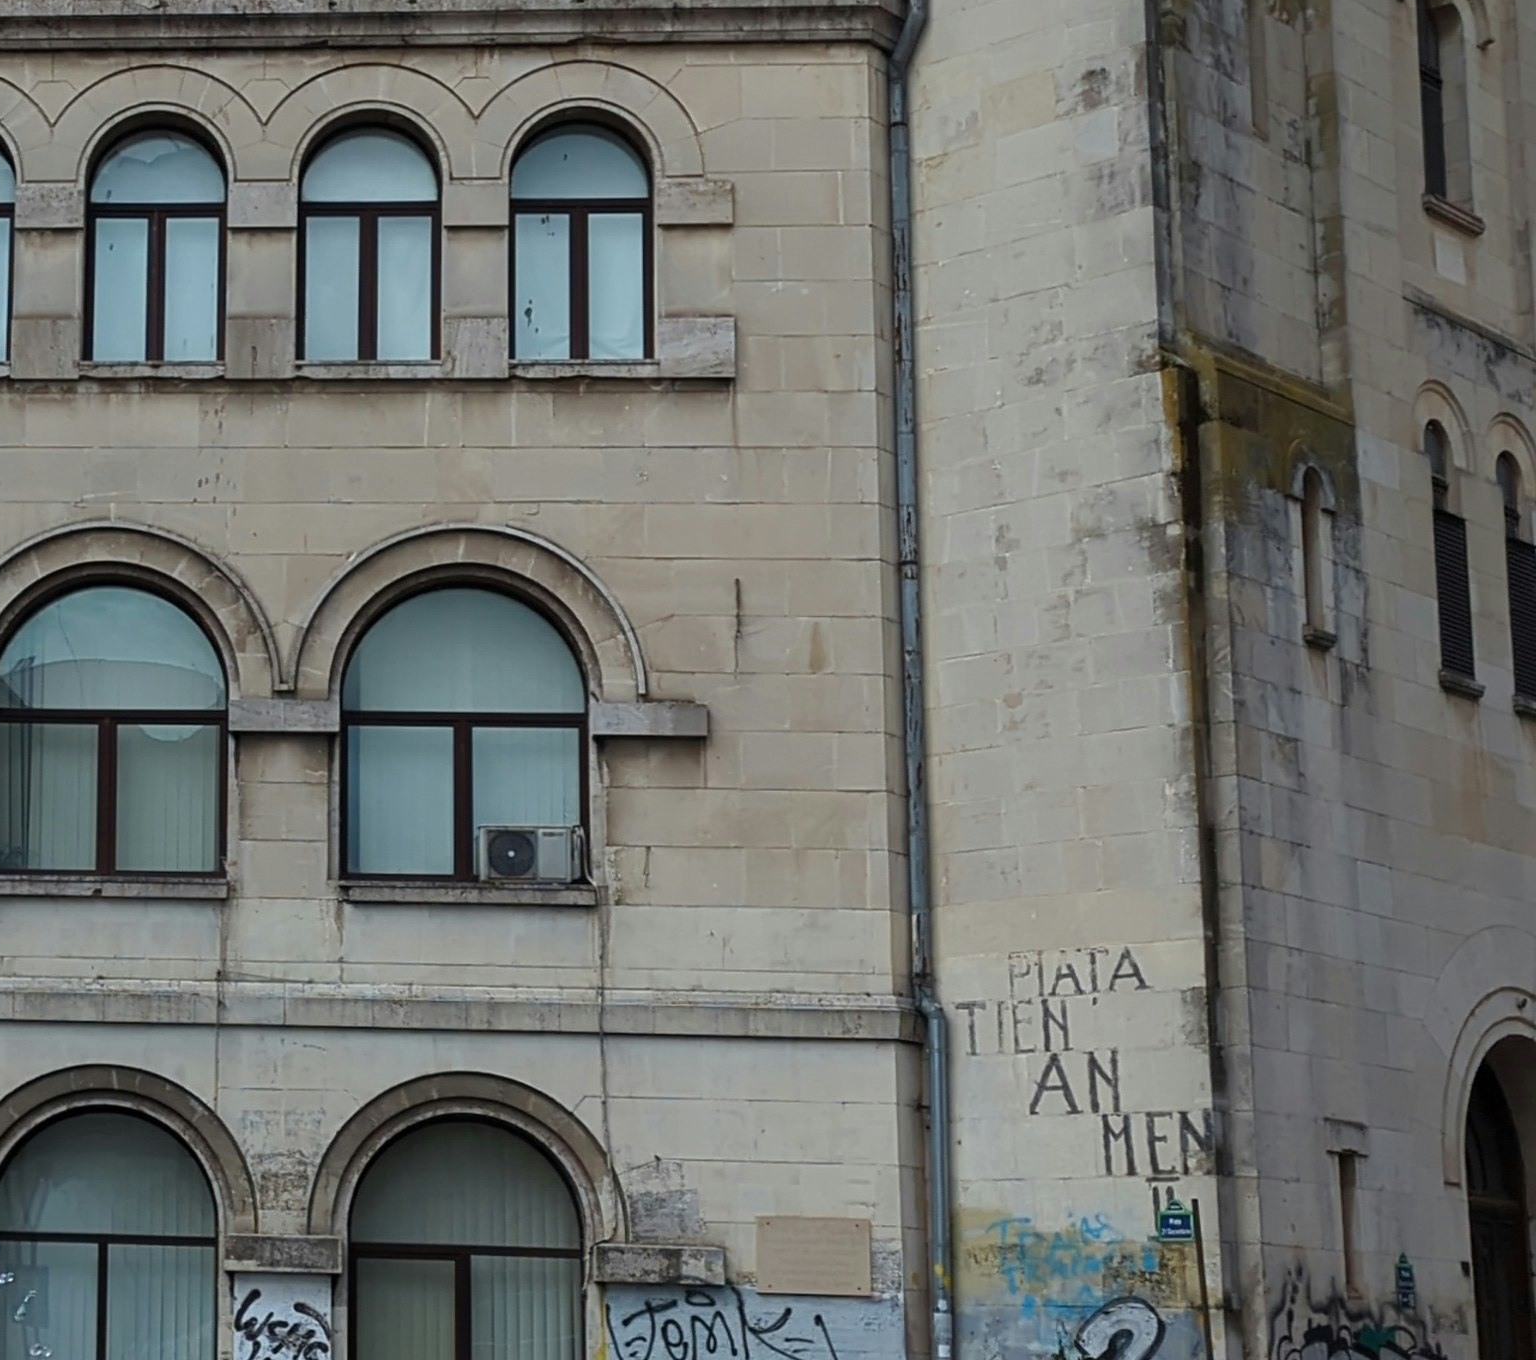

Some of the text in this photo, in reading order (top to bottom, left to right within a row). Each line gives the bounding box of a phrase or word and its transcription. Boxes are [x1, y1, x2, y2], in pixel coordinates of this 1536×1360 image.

[955, 998, 1073, 1055] TIEN
[1029, 1047, 1121, 1115] AN
[1101, 1109, 1216, 1176] MEN
